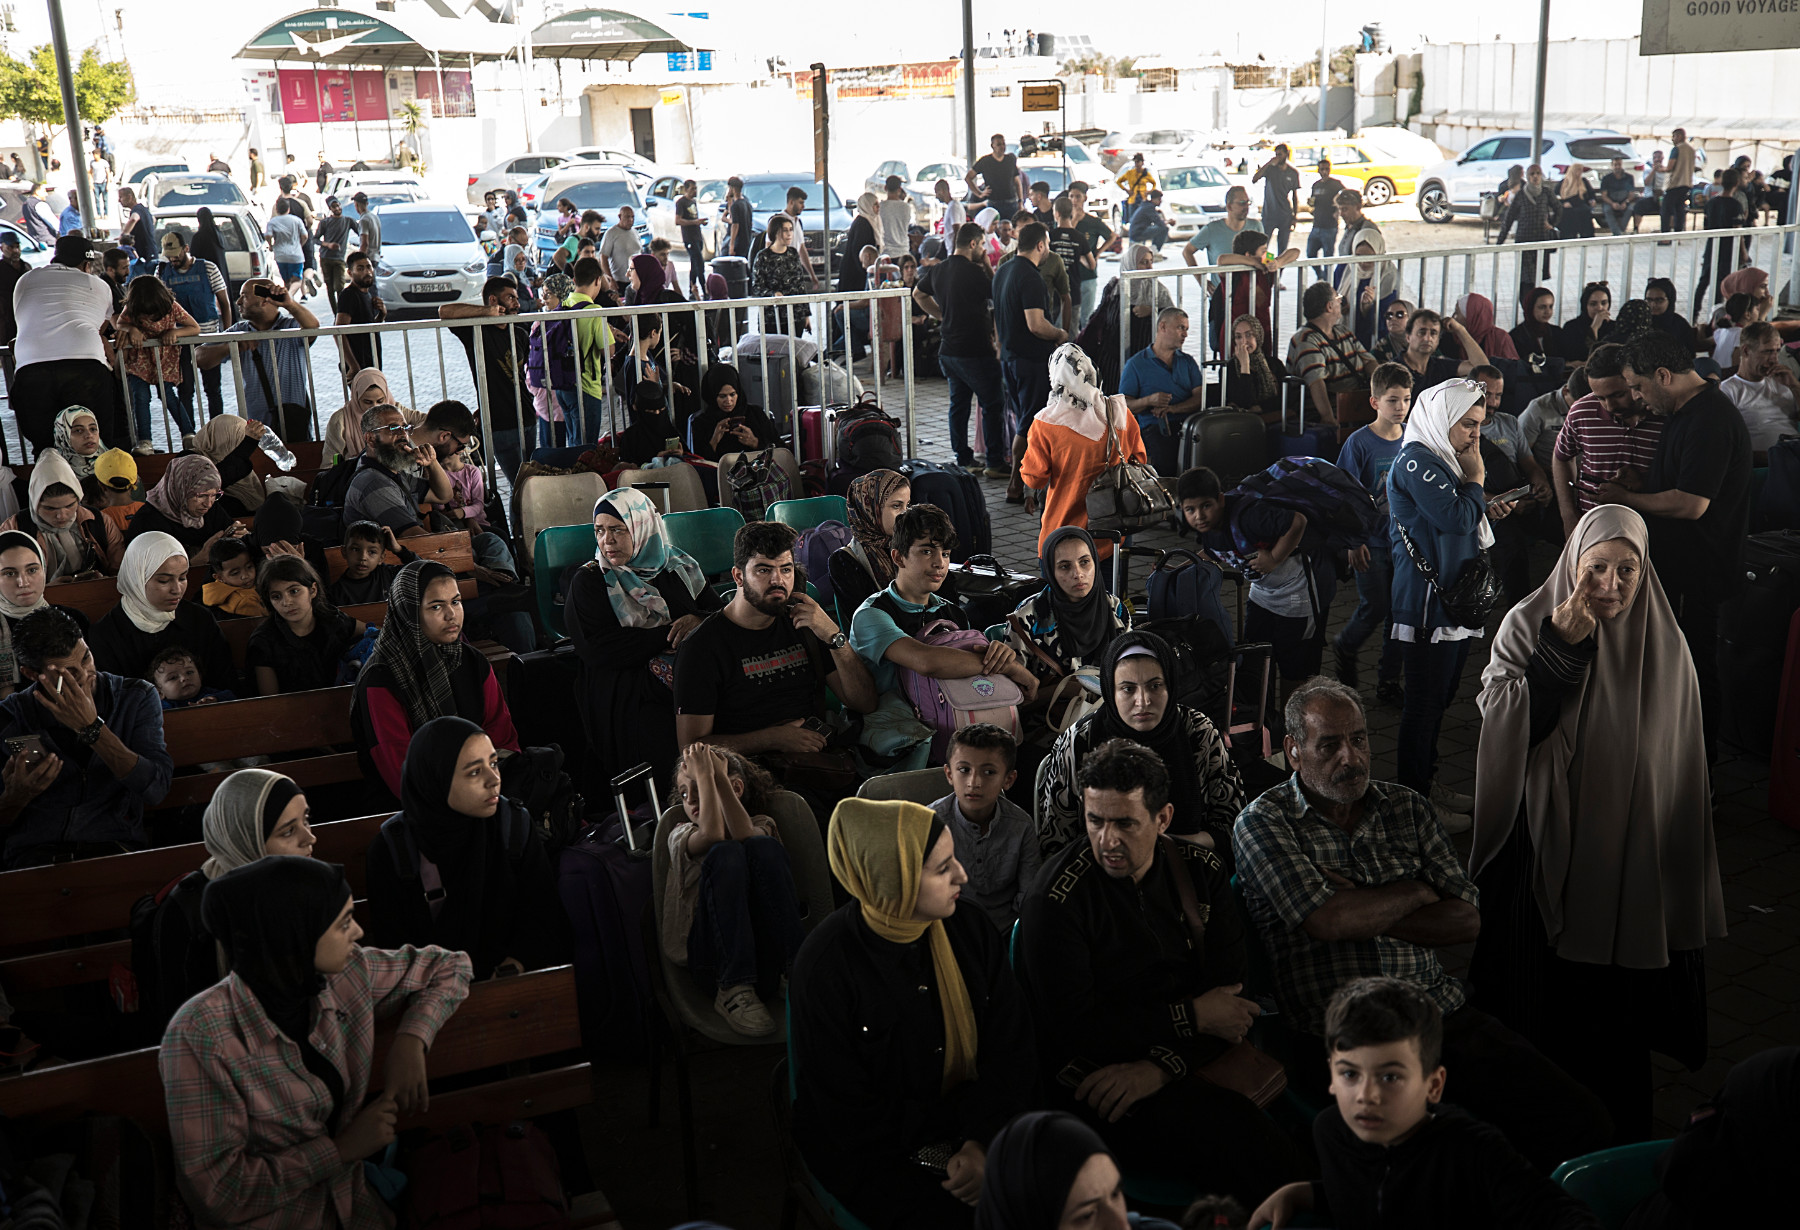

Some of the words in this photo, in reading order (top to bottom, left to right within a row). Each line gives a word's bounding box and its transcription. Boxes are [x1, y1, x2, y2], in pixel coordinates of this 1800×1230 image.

[1687, 1, 1730, 16] GOOD
[1737, 0, 1798, 14] VOYAGE
[1027, 88, 1054, 97] موقف
